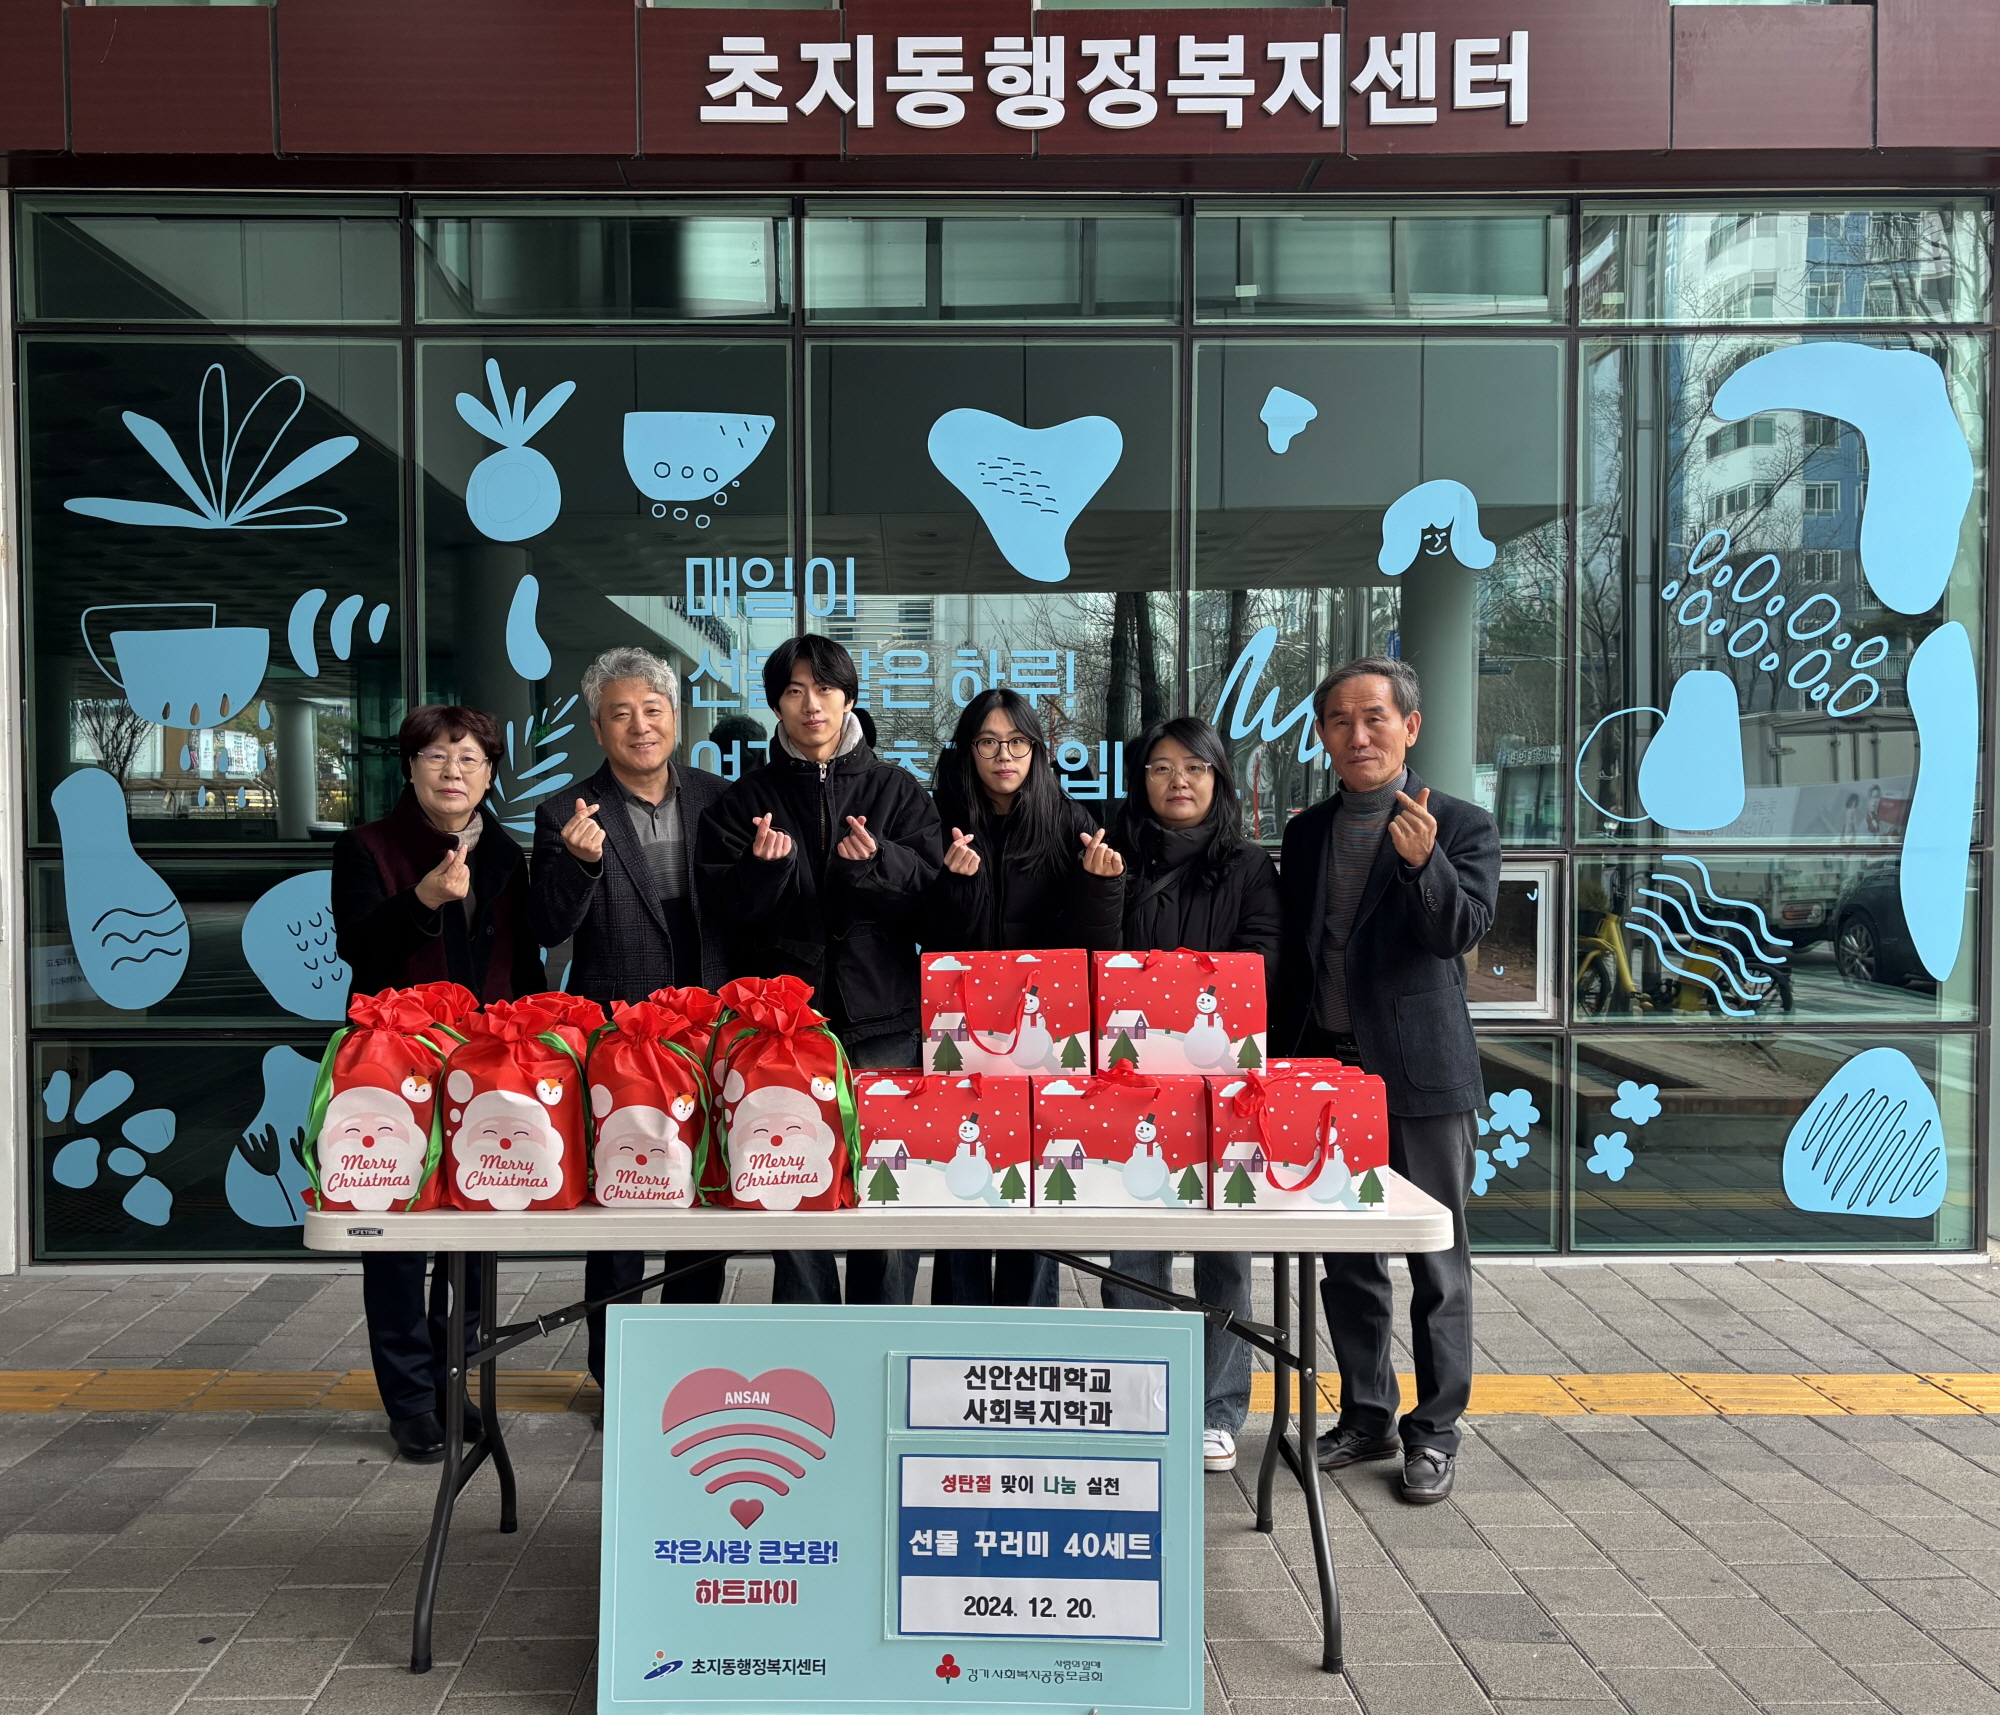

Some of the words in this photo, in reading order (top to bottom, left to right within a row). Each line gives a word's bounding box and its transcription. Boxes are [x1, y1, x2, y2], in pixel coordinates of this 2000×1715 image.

[699, 31, 1530, 129] 초지동행정복지센터
[686, 557, 855, 618] 매일이
[951, 650, 1075, 709] 하루!
[341, 1154, 397, 1173] Merry
[480, 1154, 534, 1174] Merry
[749, 1153, 805, 1171] Merry
[327, 1171, 410, 1192] Christmas
[465, 1170, 548, 1190] Christmas
[616, 1169, 671, 1190] Merry
[735, 1171, 819, 1192] Christmas
[603, 1184, 685, 1201] Christmas
[963, 1365, 1112, 1393] 신안산대학교
[724, 1390, 771, 1405] ANSAN
[963, 1399, 1113, 1427] 사회복지학과
[941, 1474, 992, 1494] 성탄절
[1001, 1475, 1034, 1494] 맞이
[1043, 1476, 1077, 1495] 나눔
[1086, 1477, 1121, 1496] 실천
[653, 1539, 752, 1565] 작은사랑
[758, 1540, 839, 1565] 큰보람!
[908, 1529, 959, 1557] 선물
[974, 1530, 1049, 1558] 꾸러미
[1063, 1532, 1152, 1560] 40세트
[695, 1578, 799, 1606] 하트파이
[963, 1595, 1018, 1617] 2024.
[1028, 1596, 1057, 1618] 12.
[1066, 1598, 1096, 1619] 20.
[690, 1658, 827, 1676] 초지동행정복지센터
[966, 1668, 989, 1682] 경기
[991, 1668, 1103, 1684] 사회복지공동모금회
